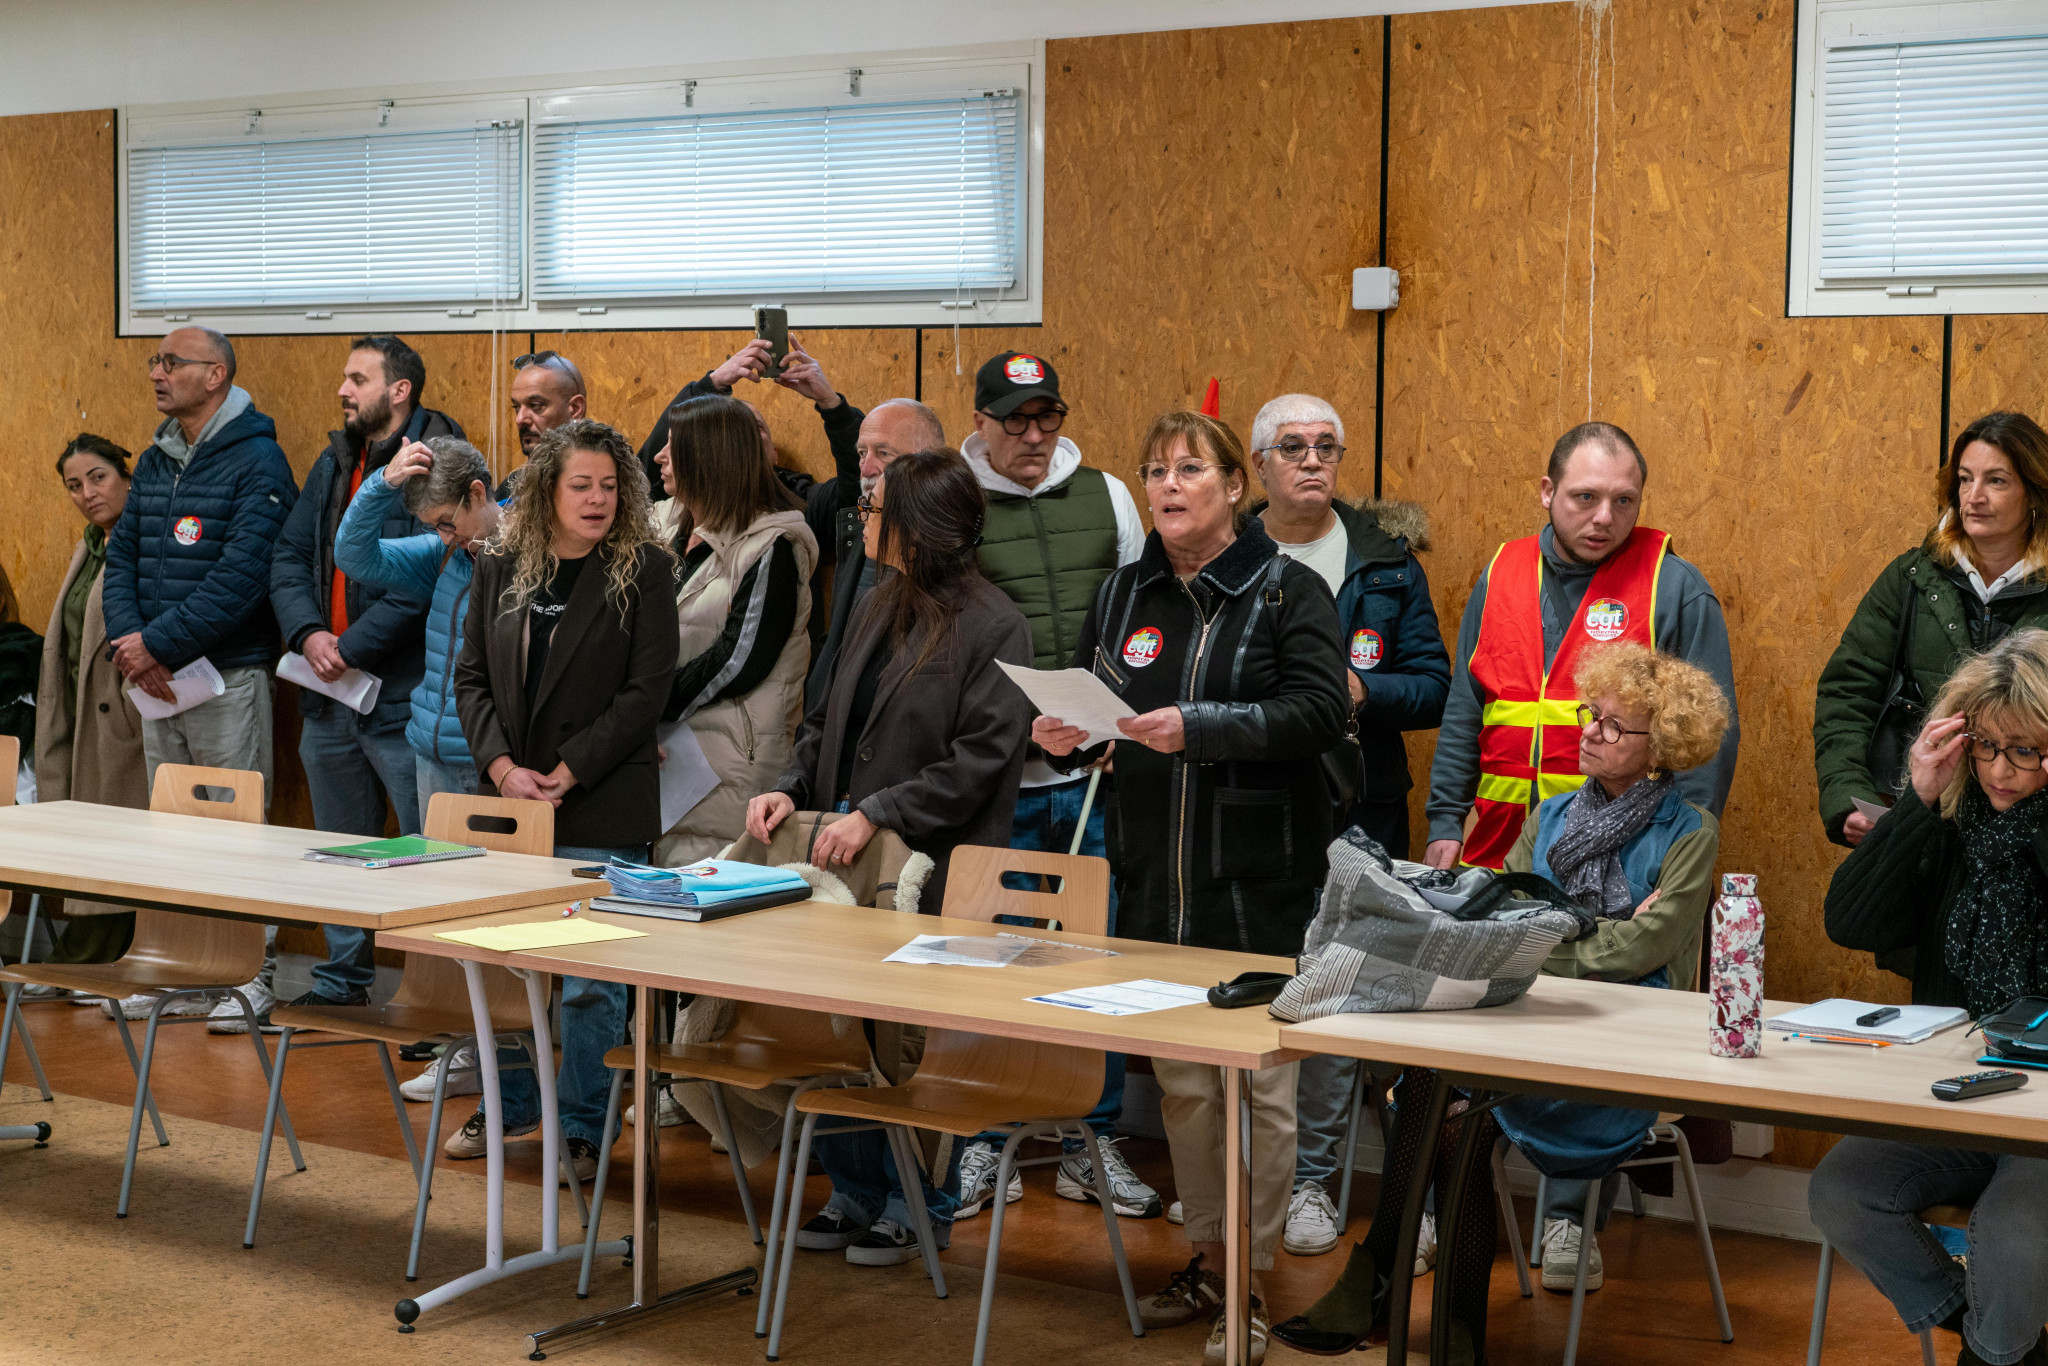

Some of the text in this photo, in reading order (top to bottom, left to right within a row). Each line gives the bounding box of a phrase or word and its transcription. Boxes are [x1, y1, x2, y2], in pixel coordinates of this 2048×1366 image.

[1587, 610, 1621, 632] cgt
[1127, 640, 1157, 658] cgt
[1352, 641, 1378, 659] cgt
